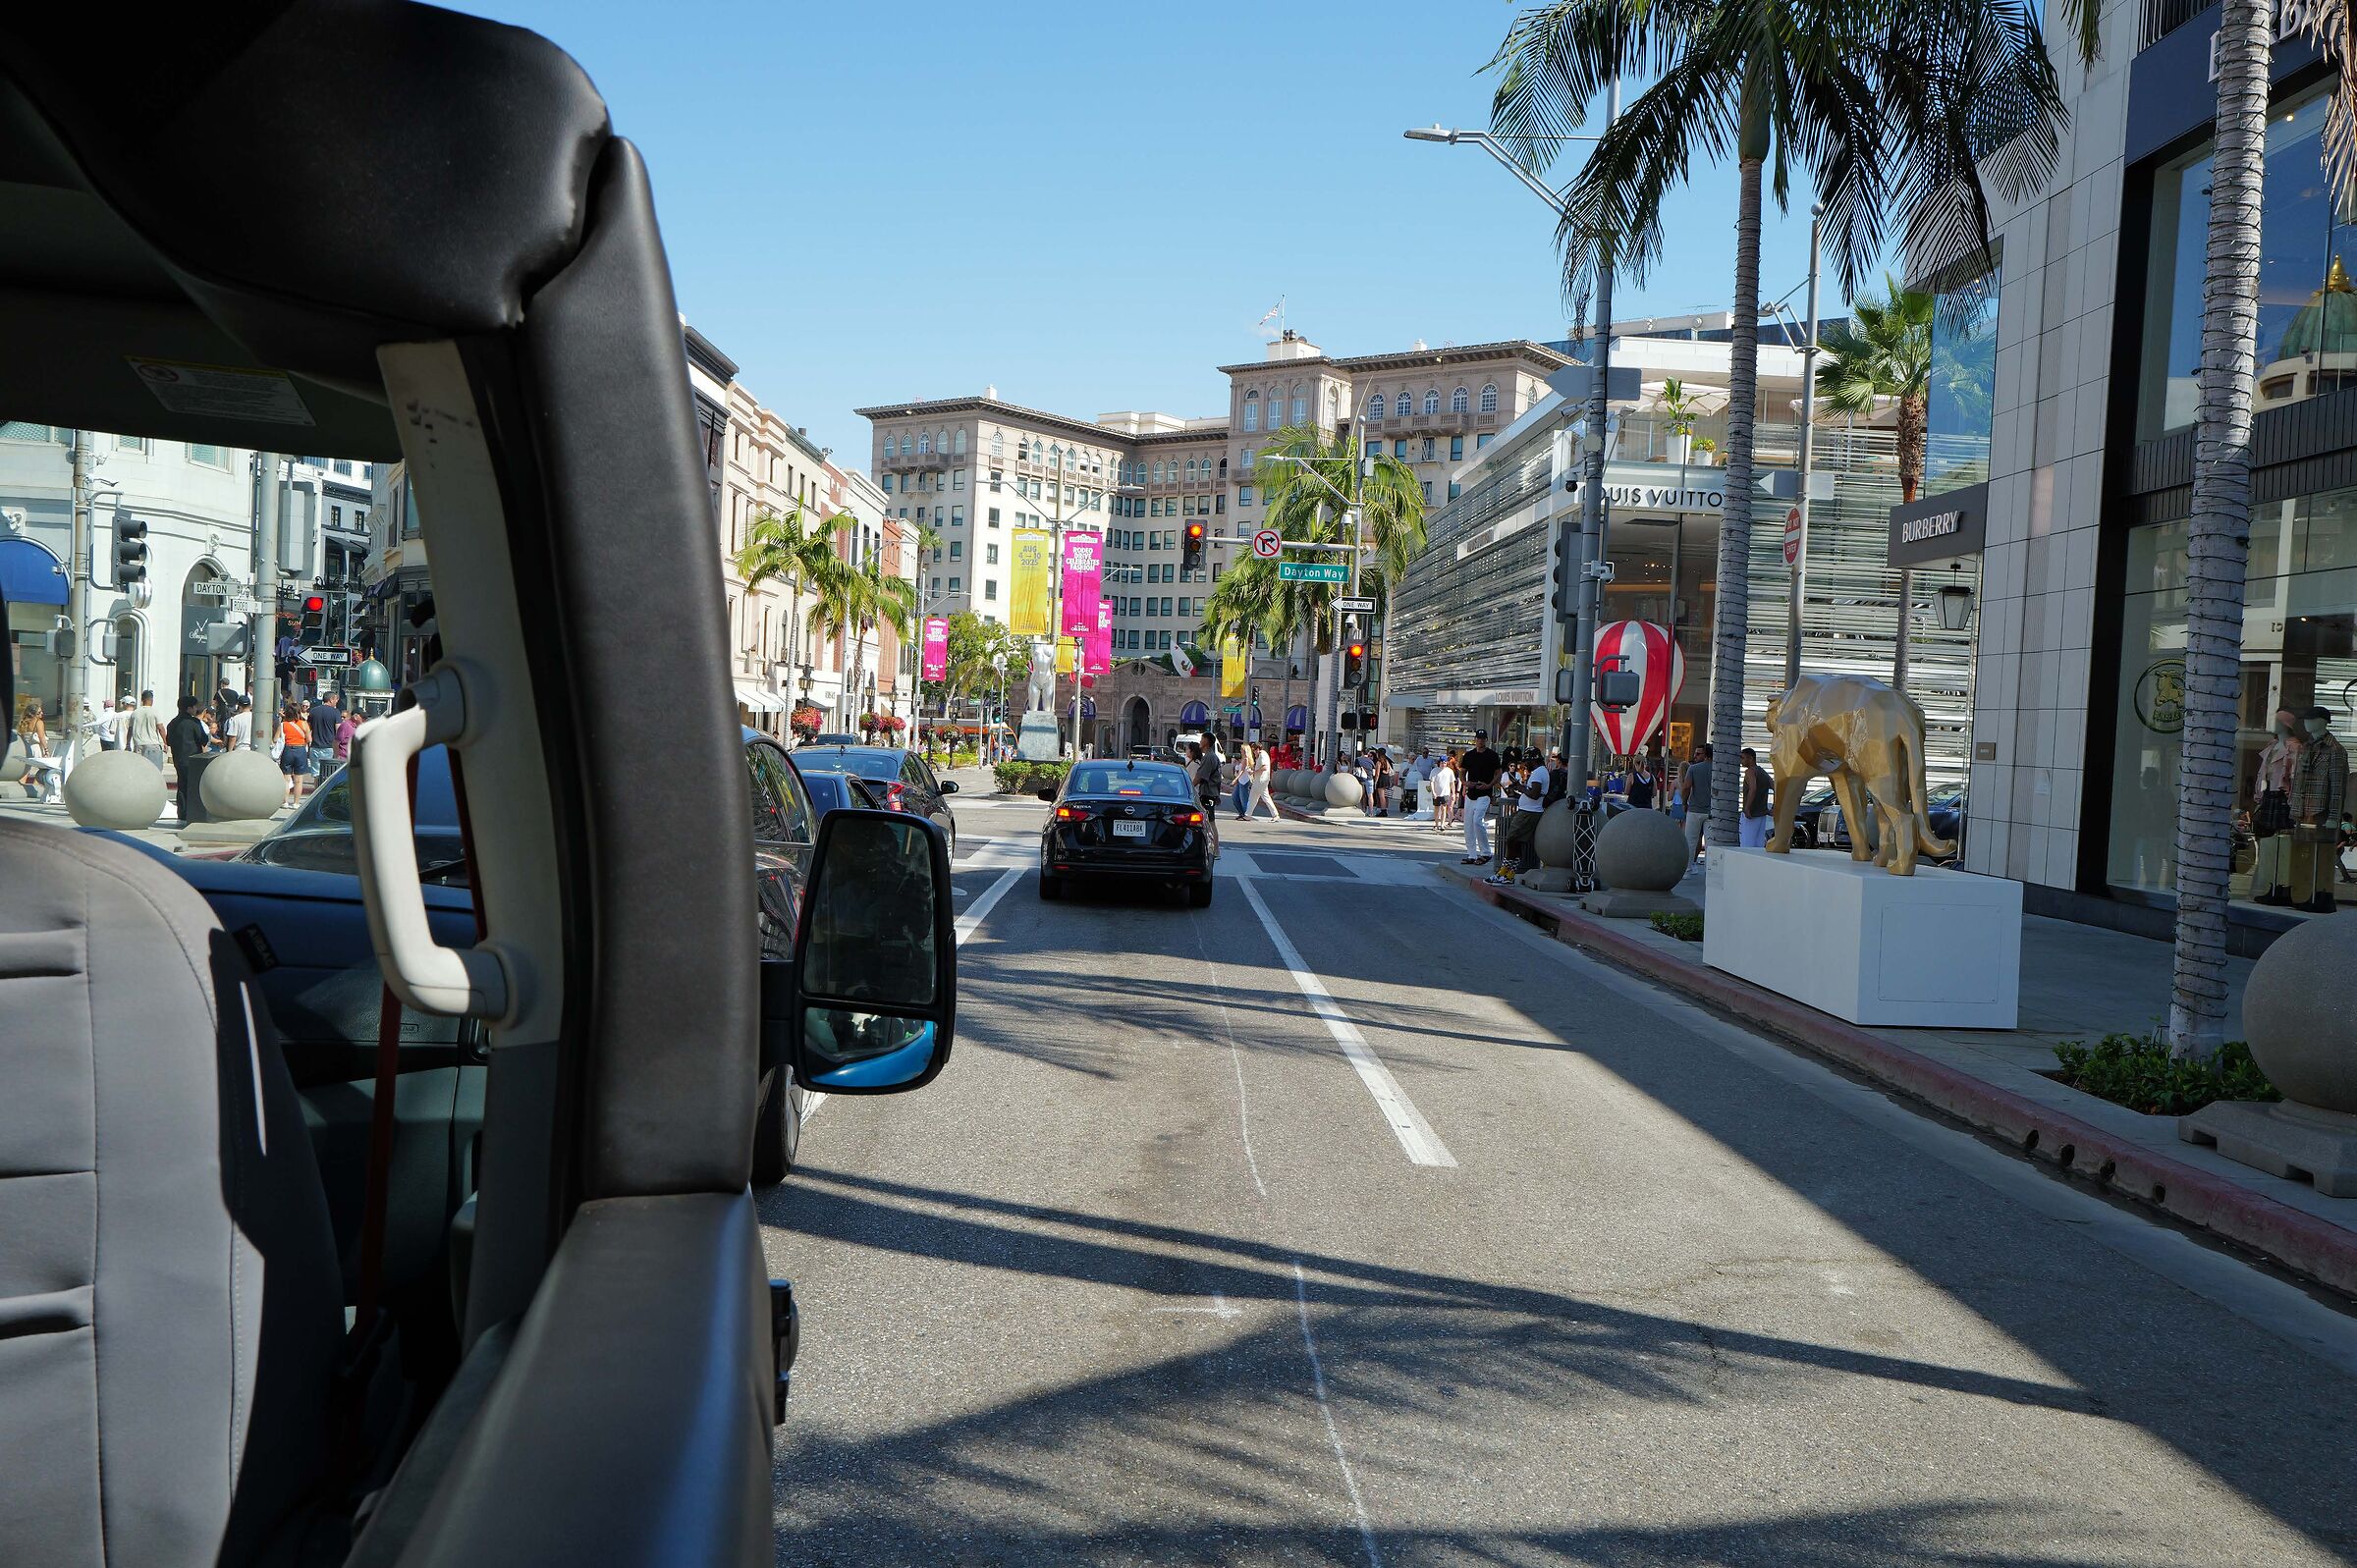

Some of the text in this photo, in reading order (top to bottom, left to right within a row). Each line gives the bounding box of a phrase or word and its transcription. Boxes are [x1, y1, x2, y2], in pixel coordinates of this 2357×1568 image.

[1582, 485, 1725, 508] UIS VUITTO
[1901, 510, 1959, 543] BURBERRY
[1072, 546, 1093, 555] RODEO
[1284, 567, 1344, 580] Dayton Way
[196, 583, 227, 594] DAYTON
[234, 600, 247, 611] RODEO
[1495, 690, 1535, 703] LOUIS VUITTON
